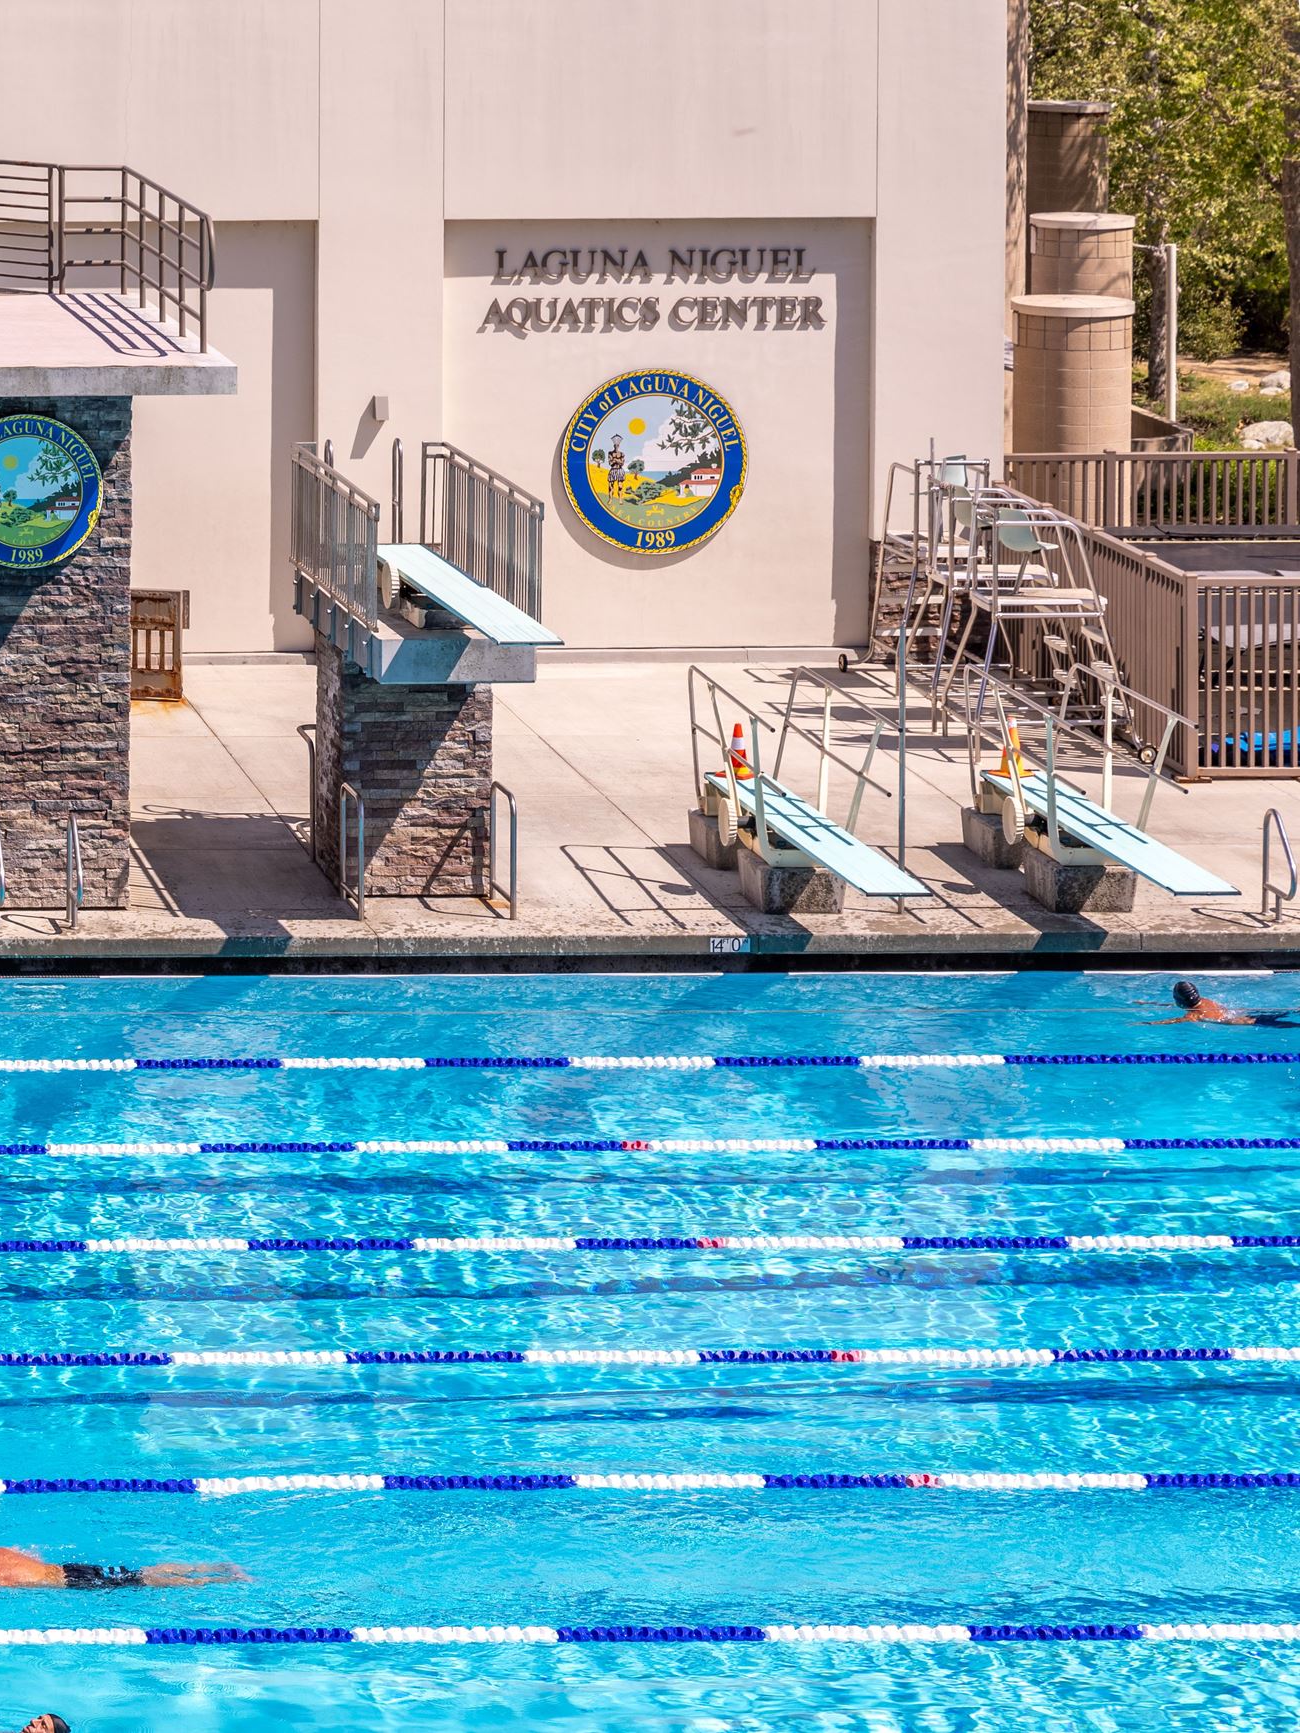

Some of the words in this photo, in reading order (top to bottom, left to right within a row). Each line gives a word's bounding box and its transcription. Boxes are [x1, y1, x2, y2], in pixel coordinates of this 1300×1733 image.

[495, 249, 654, 277] LAGUNA
[668, 248, 816, 276] NIGUEL
[482, 297, 660, 331] AQUATICS
[672, 296, 828, 324] CENTER
[571, 408, 599, 452] CITY
[600, 392, 614, 412] of
[614, 376, 689, 401] LAGUNA
[692, 389, 739, 452] NIGUEL
[56, 431, 96, 483] NIGUEL
[11, 548, 44, 562] 1989
[636, 530, 676, 548] 1989
